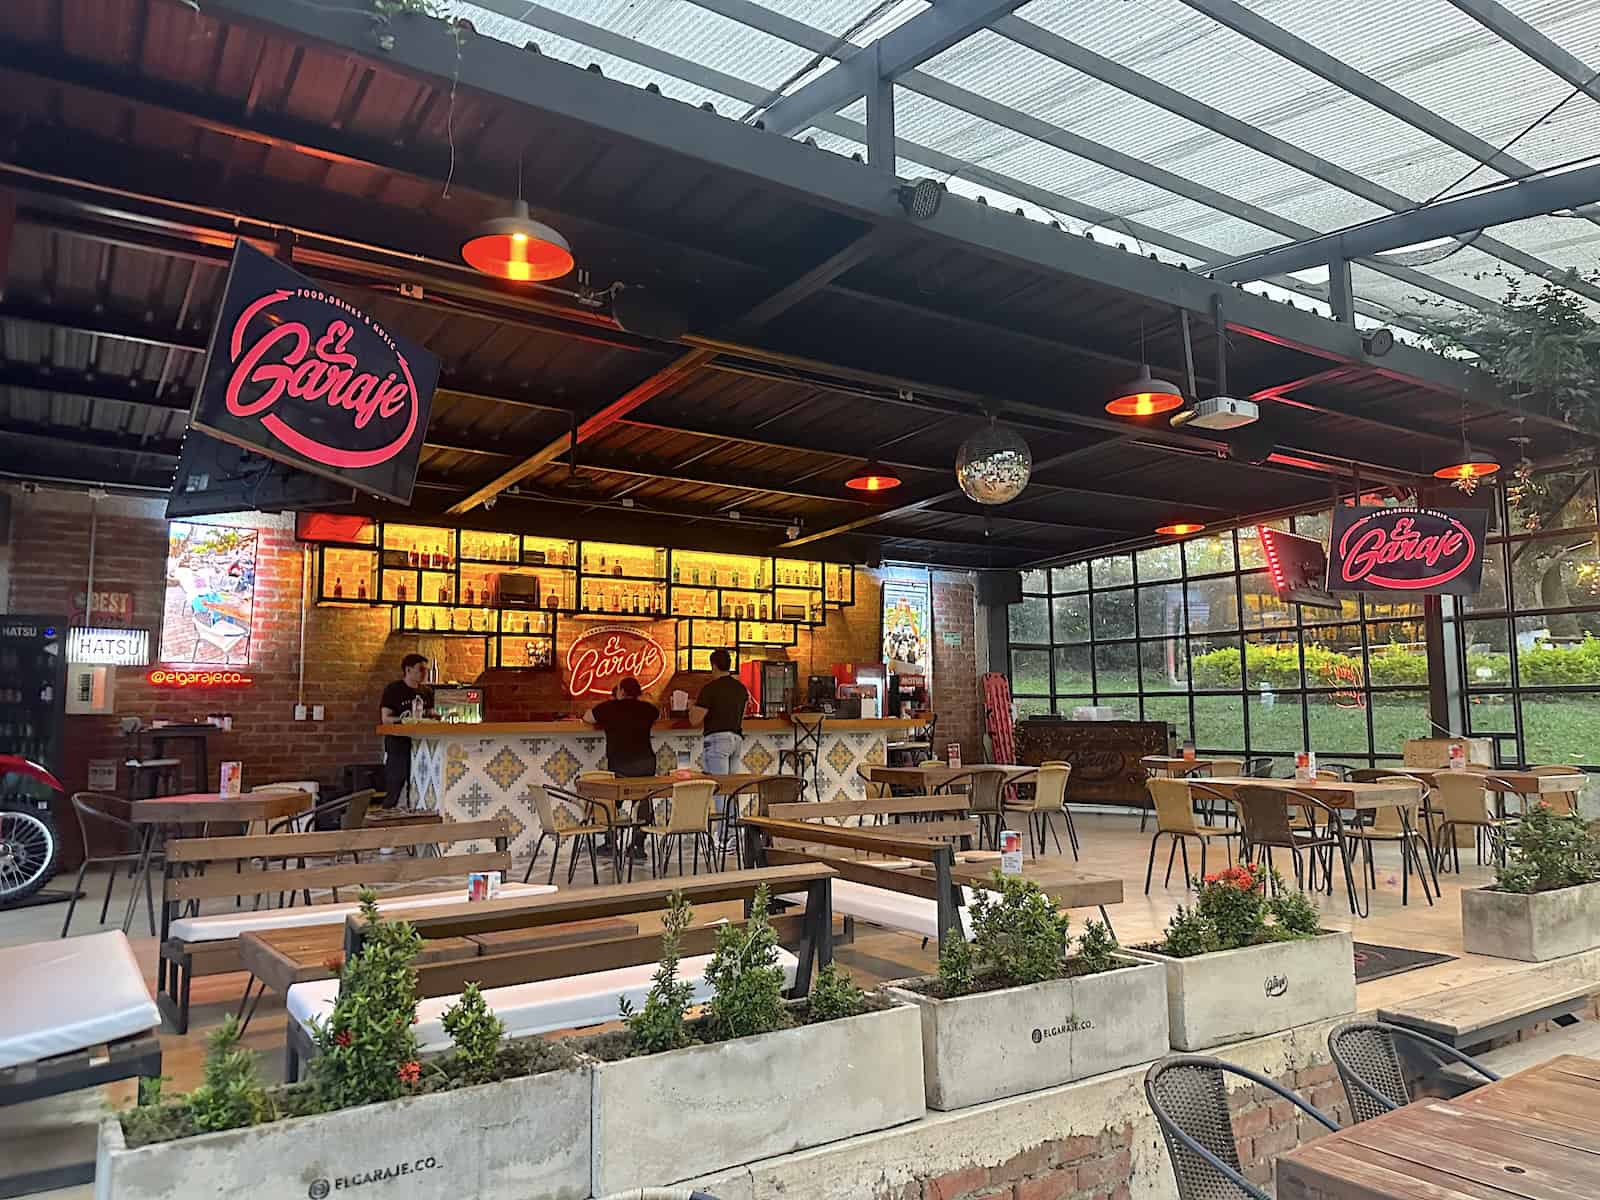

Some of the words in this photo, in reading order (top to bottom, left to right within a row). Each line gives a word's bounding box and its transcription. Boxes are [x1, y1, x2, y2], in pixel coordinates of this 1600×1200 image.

[315, 320, 358, 368] El
[372, 322, 397, 351] MUSIC
[225, 321, 410, 430] Garaje
[1390, 517, 1421, 541] El
[1342, 528, 1464, 582] Garaje
[2, 626, 38, 638] HATSU
[603, 635, 627, 656] El
[79, 638, 140, 656] HATSU
[569, 645, 658, 696] Garaje
